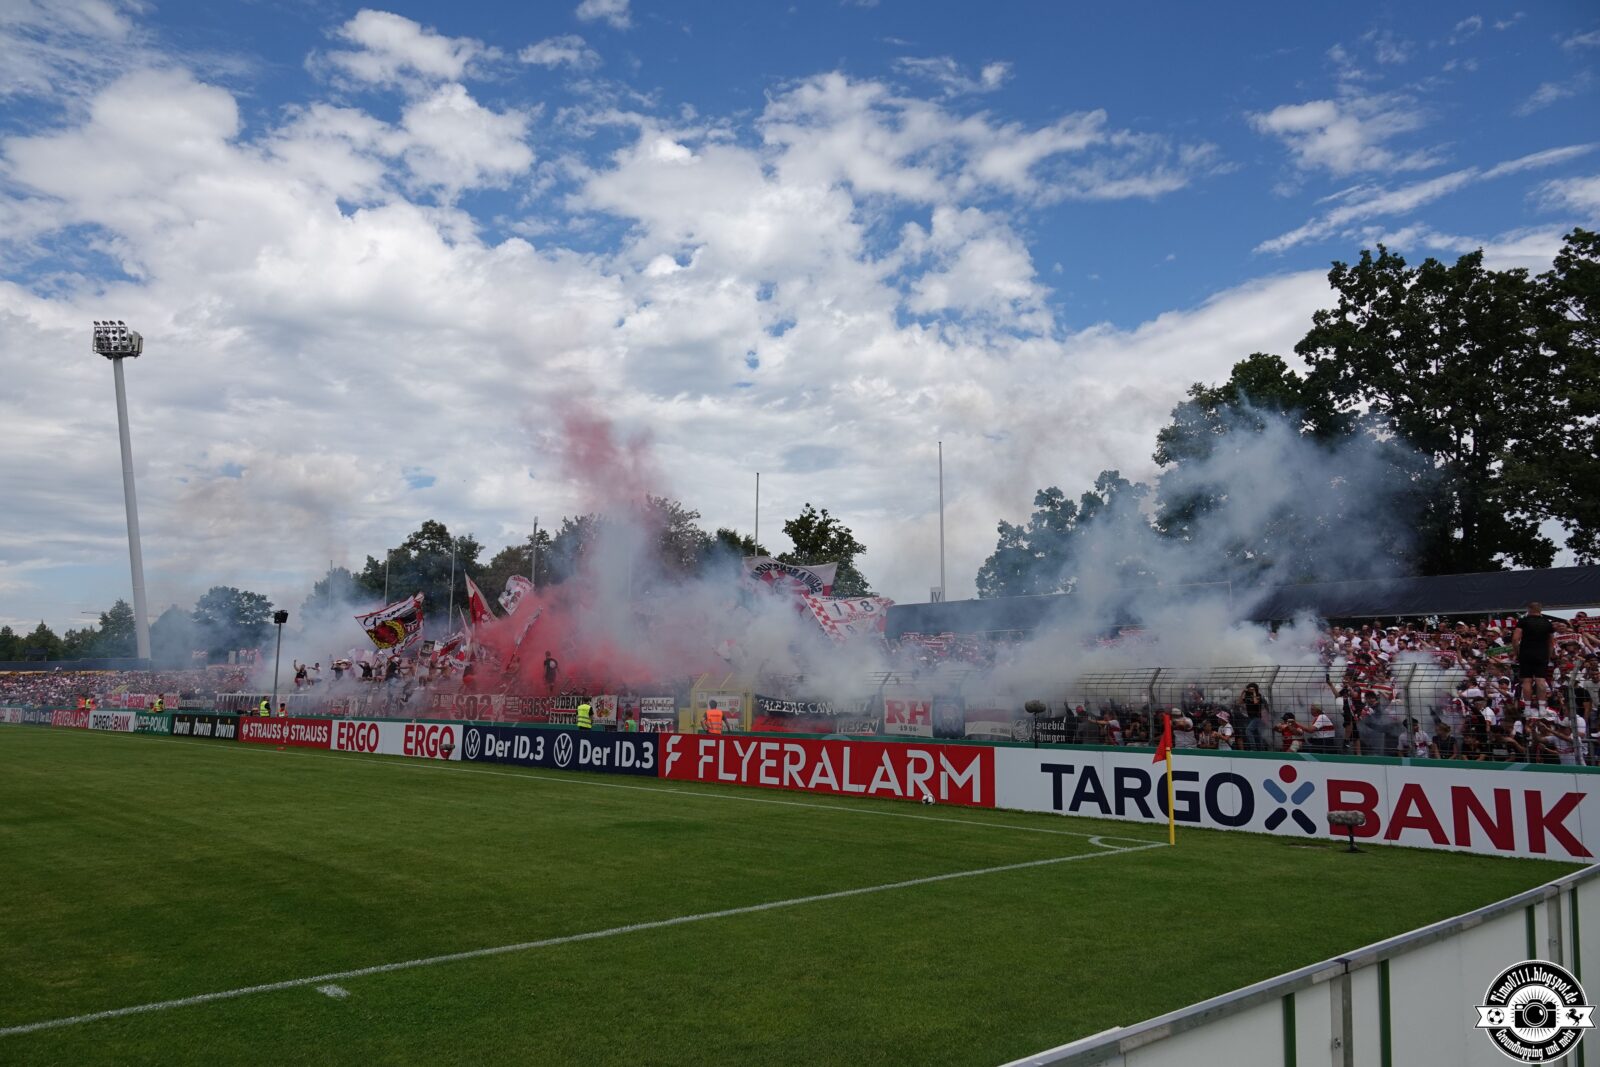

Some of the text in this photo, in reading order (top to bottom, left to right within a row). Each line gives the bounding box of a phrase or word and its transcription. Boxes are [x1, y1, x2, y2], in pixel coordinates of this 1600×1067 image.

[93, 714, 131, 732] TARGO BANK
[173, 717, 235, 739] bwin bwin bwin
[886, 699, 932, 726] RH
[249, 722, 328, 743] STRAUSS STRAUSS
[336, 721, 454, 759] ERGO ERGO
[484, 734, 511, 758] Der
[513, 735, 545, 761] ID.3
[578, 739, 610, 766] Der
[614, 741, 654, 769] ID.3
[698, 739, 981, 804] FLYERALARM
[1040, 763, 1594, 858] TARGO BANK
